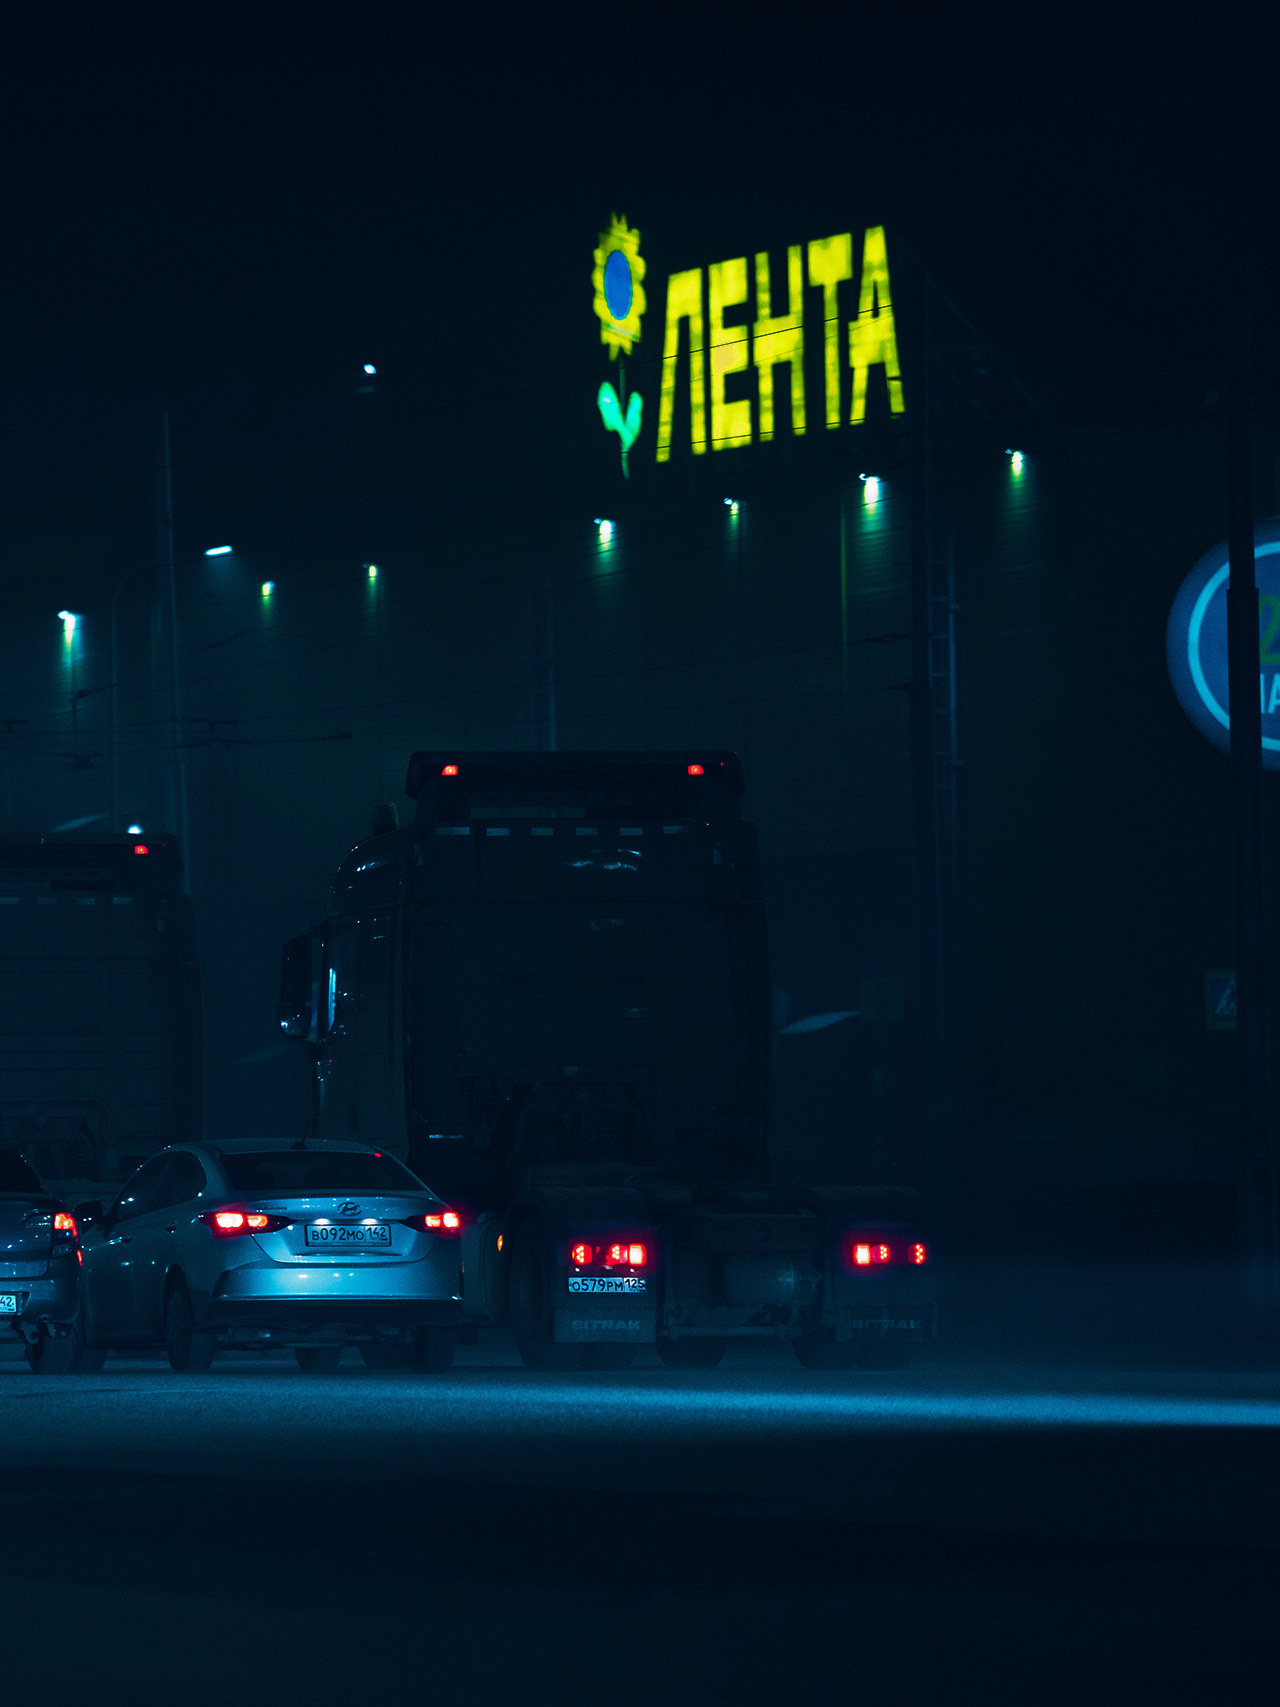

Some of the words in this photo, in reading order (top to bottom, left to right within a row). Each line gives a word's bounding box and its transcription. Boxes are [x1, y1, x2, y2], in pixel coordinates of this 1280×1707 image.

[656, 225, 906, 463] ЛЕНТА
[311, 1227, 364, 1241] В092МО
[366, 1227, 386, 1238] 142
[572, 1278, 623, 1292] О579РМ
[625, 1278, 644, 1288] 125
[570, 1319, 641, 1330] SITRAK
